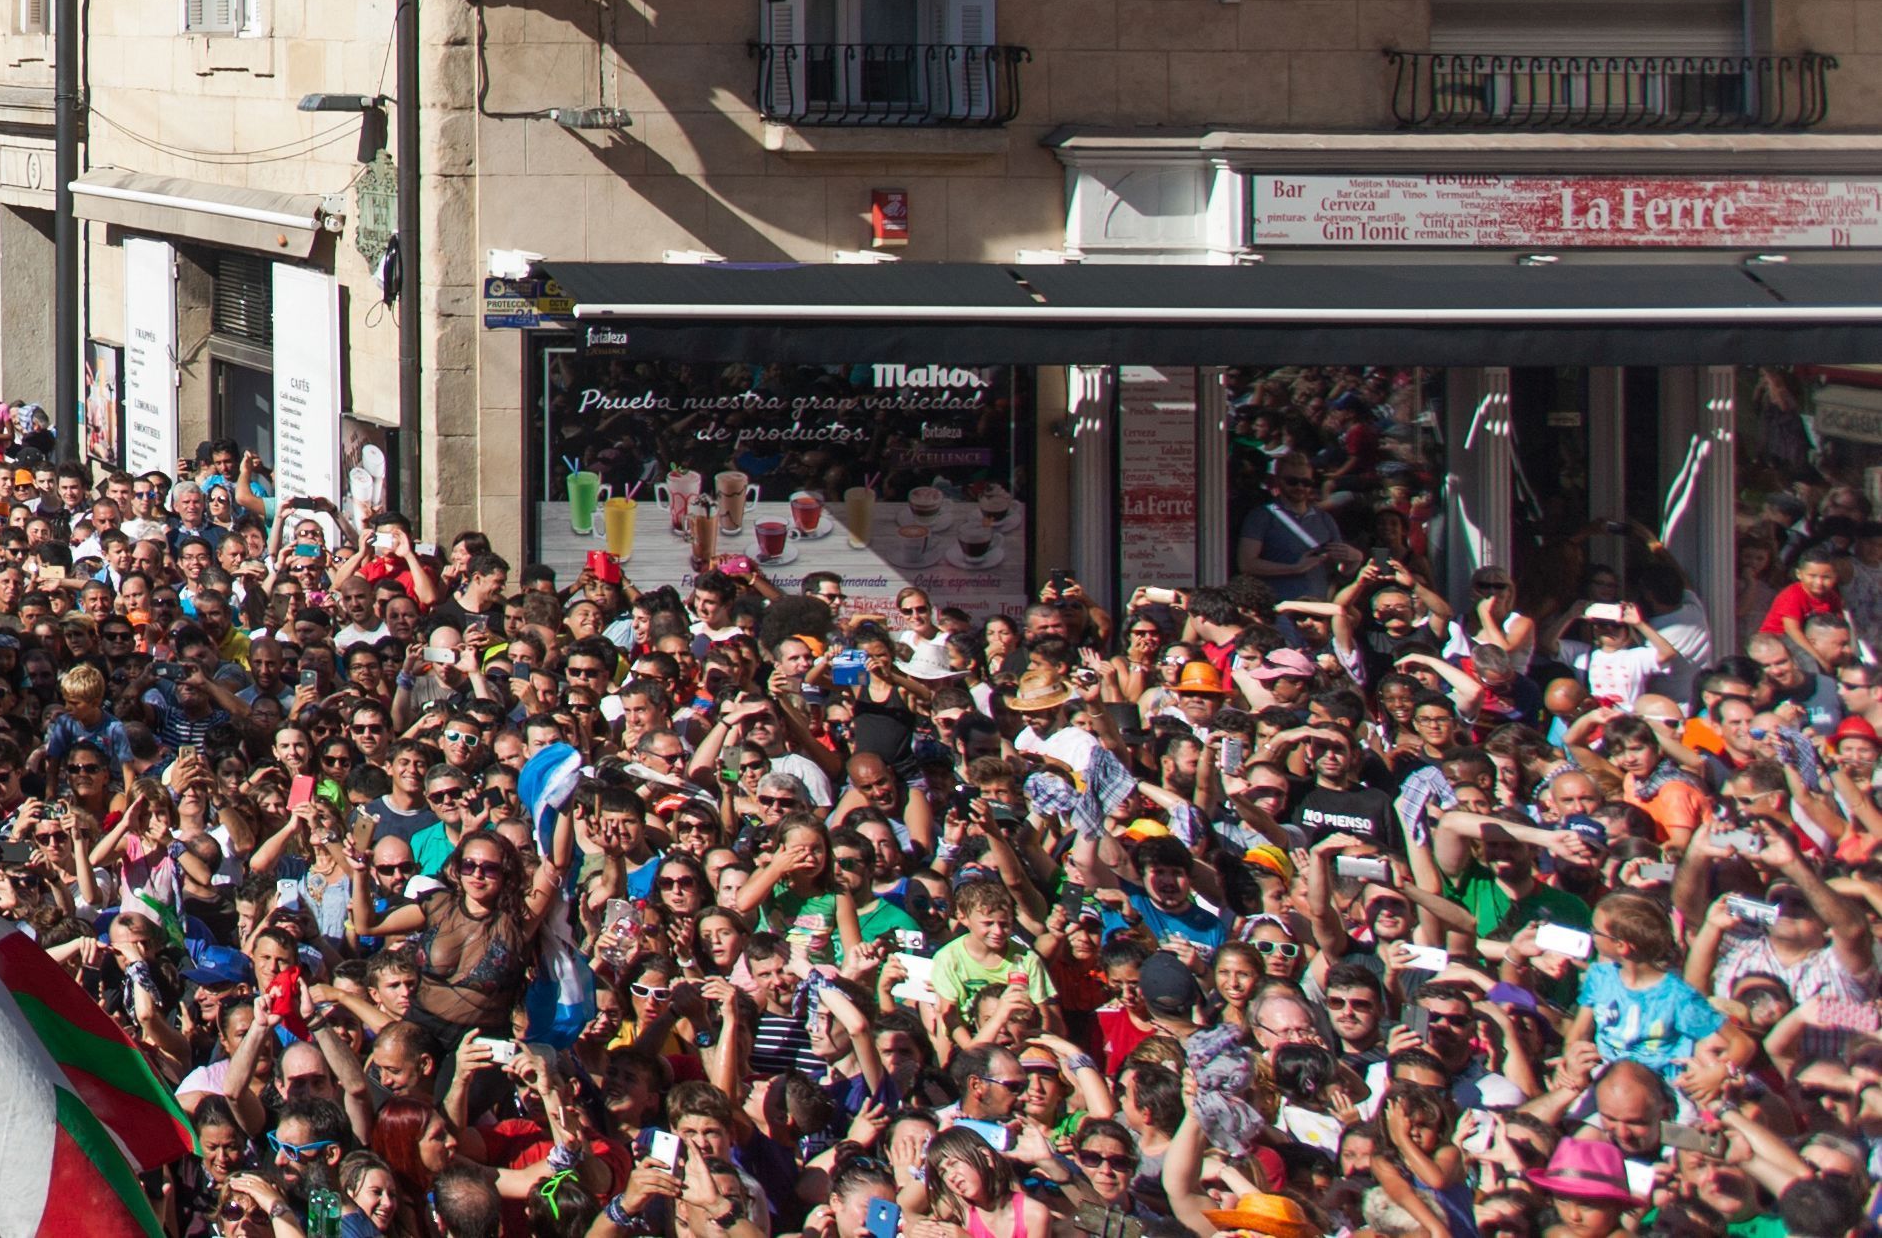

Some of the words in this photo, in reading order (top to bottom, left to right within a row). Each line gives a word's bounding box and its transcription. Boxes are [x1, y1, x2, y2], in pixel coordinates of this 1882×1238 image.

[1273, 180, 1306, 198] Bar
[1348, 179, 1383, 189] Mojitos
[1845, 182, 1878, 194] Vinos
[1337, 190, 1352, 199] Bar
[1353, 190, 1390, 199] Cocktail
[1402, 190, 1427, 199] Vinos
[1436, 190, 1481, 199] Vermouth
[1321, 197, 1376, 211] Cerveza
[1560, 188, 1611, 230] La
[1619, 188, 1736, 231] Ferre
[1268, 213, 1306, 223] pinturas
[1313, 213, 1363, 223] desayunos
[1367, 213, 1406, 223] martillo
[1423, 216, 1455, 229] Cinta
[1322, 222, 1354, 240] Gin
[1358, 222, 1409, 240] Tonic
[1414, 229, 1470, 239] remaches
[586, 327, 627, 347] fortaleza
[291, 377, 310, 393] CAFÉS
[578, 388, 678, 413] Prueba
[682, 390, 787, 410] nuestra
[791, 396, 859, 420] gran
[863, 390, 985, 410] variedad
[695, 421, 731, 441] de
[734, 421, 871, 450] productos.
[921, 421, 962, 441] fortaleza
[1123, 495, 1143, 515] La
[841, 574, 888, 588] imonada
[914, 573, 945, 590] Cafés
[947, 573, 1002, 591] especiales
[998, 602, 1023, 616] Ten
[1303, 808, 1323, 824] NO
[1324, 813, 1373, 831] PIENSO
